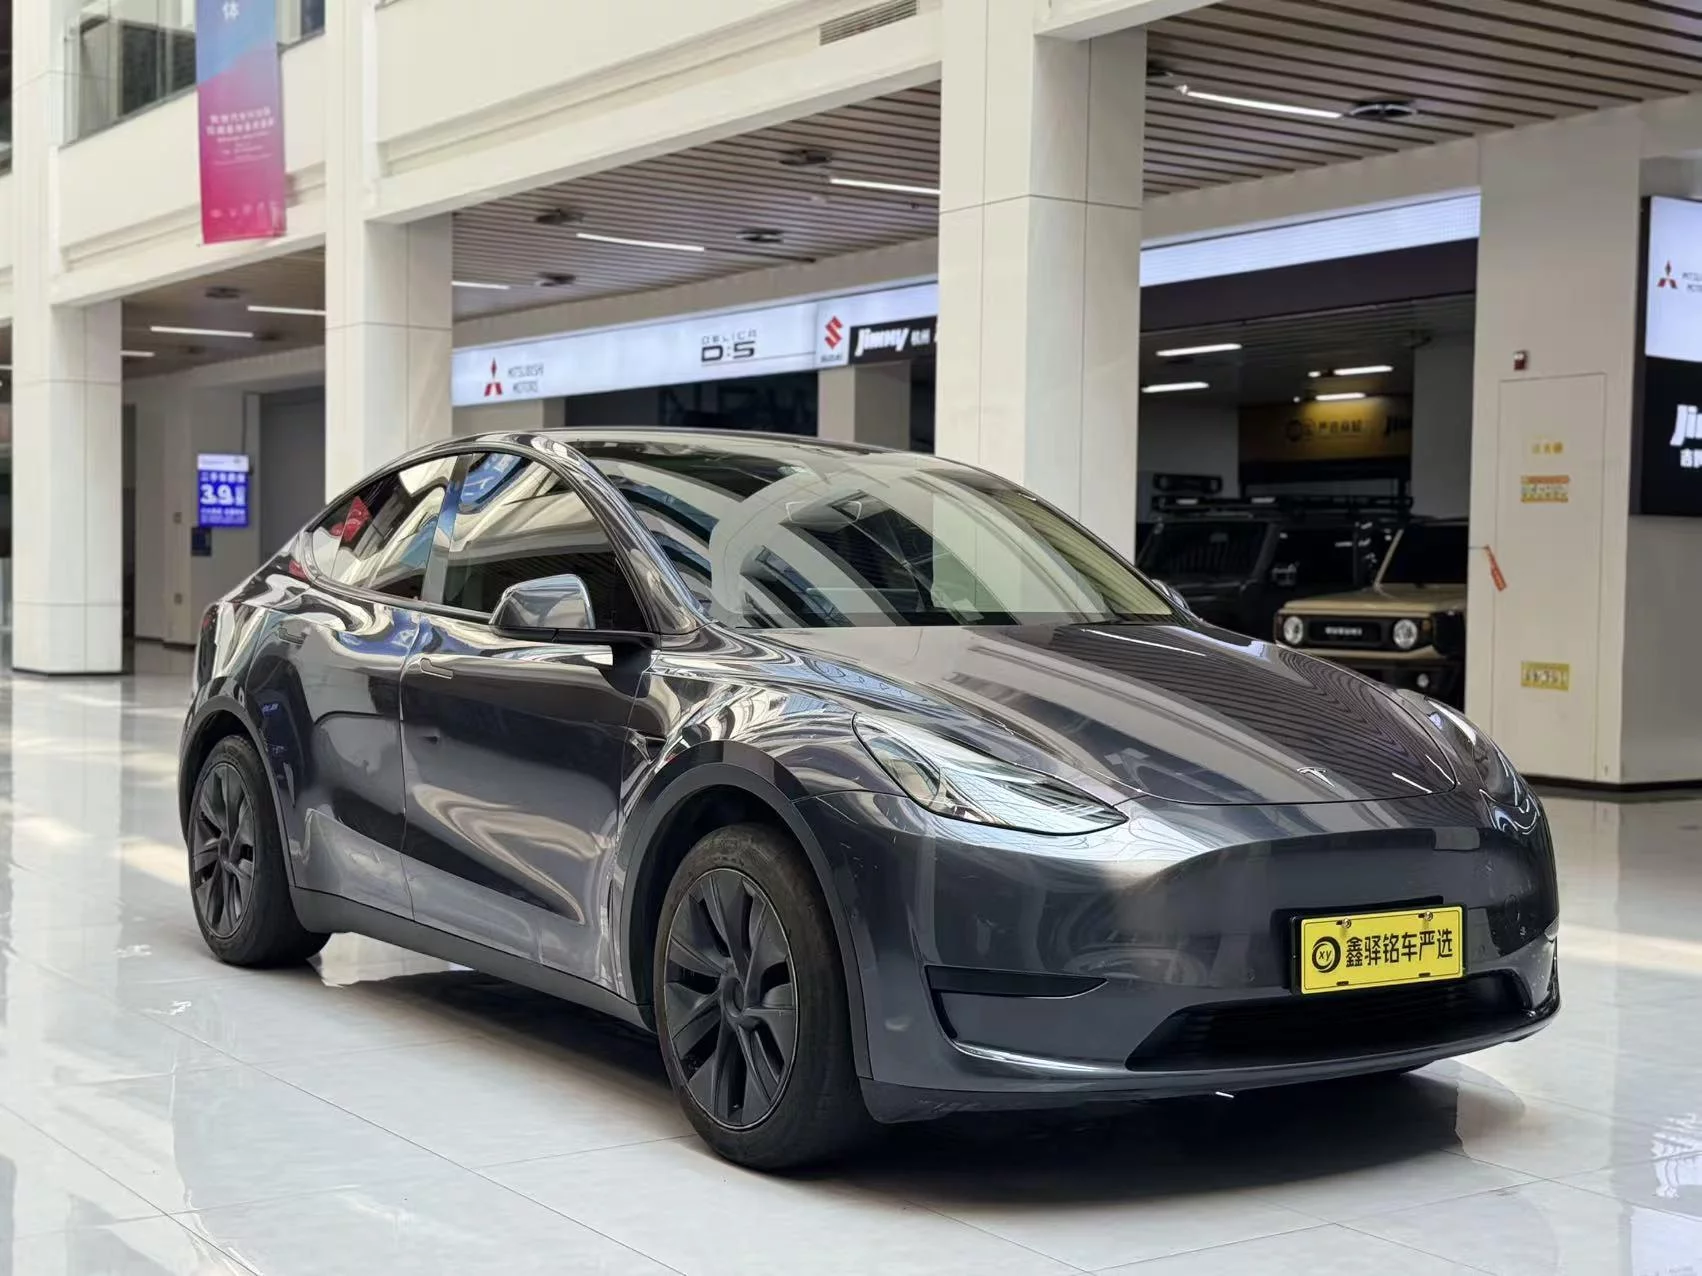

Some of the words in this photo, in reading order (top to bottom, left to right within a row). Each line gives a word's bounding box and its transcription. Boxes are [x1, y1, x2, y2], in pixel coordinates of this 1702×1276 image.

[701, 340, 756, 362] D:5
[1345, 928, 1454, 968] 鑫驿铭车严选
